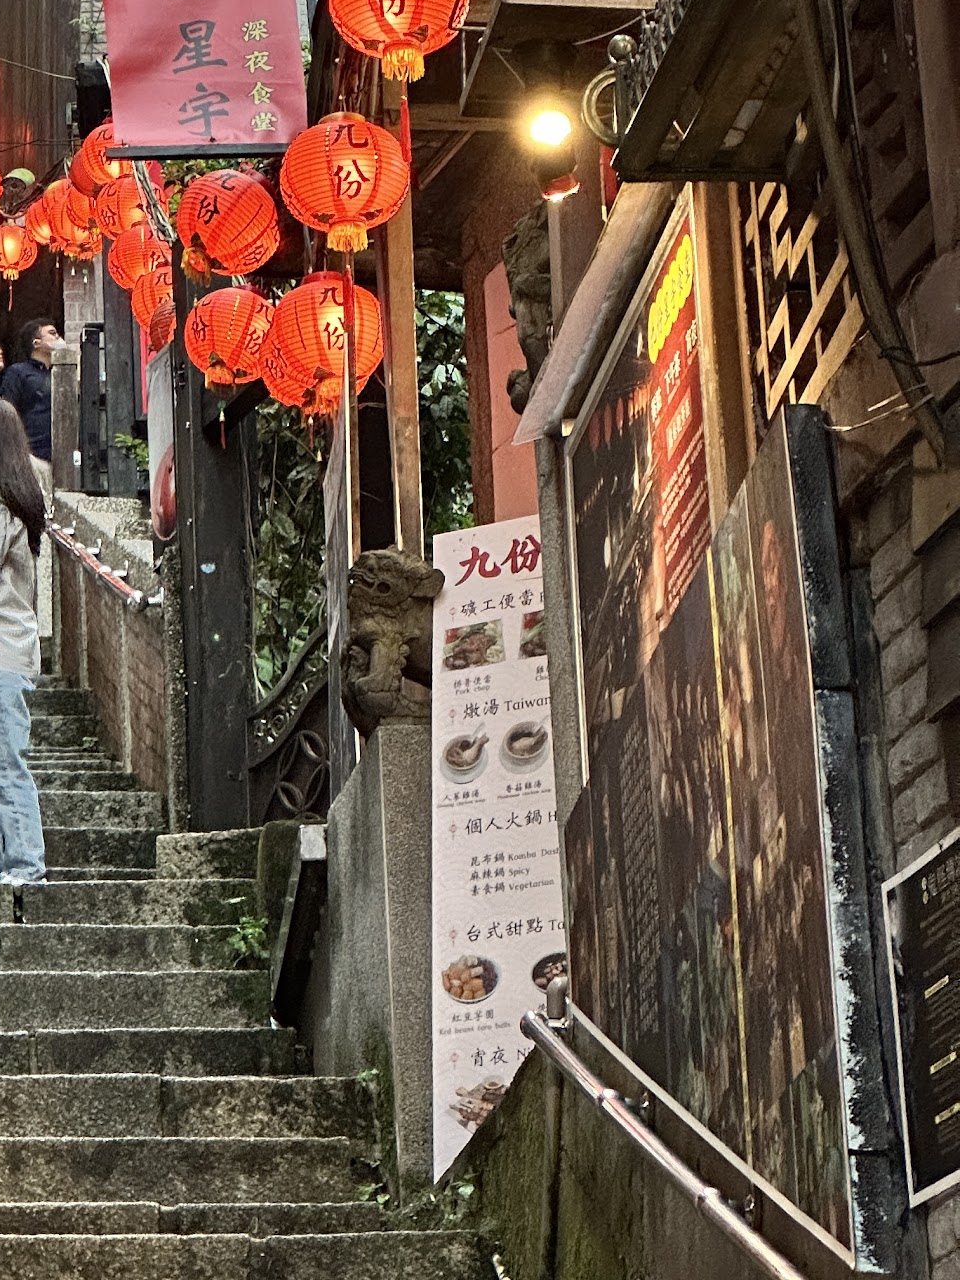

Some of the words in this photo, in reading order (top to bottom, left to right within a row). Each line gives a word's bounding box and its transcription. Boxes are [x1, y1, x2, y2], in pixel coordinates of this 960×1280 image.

[241, 18, 279, 133] 深夜食堂
[331, 124, 371, 200] 九份
[454, 533, 542, 587] 九份
[460, 588, 534, 618] 礦工便當
[463, 698, 500, 720] 燉湯
[465, 809, 543, 836] 個人火鍋
[470, 853, 506, 867] 昆布鍋
[470, 867, 506, 881] 麻辣鍋
[508, 867, 531, 877] Spicy
[470, 882, 506, 897] 素食鍋
[508, 878, 555, 891] Vegetarian
[467, 917, 544, 943] 台式甜點
[470, 1046, 509, 1068] 宵夜
